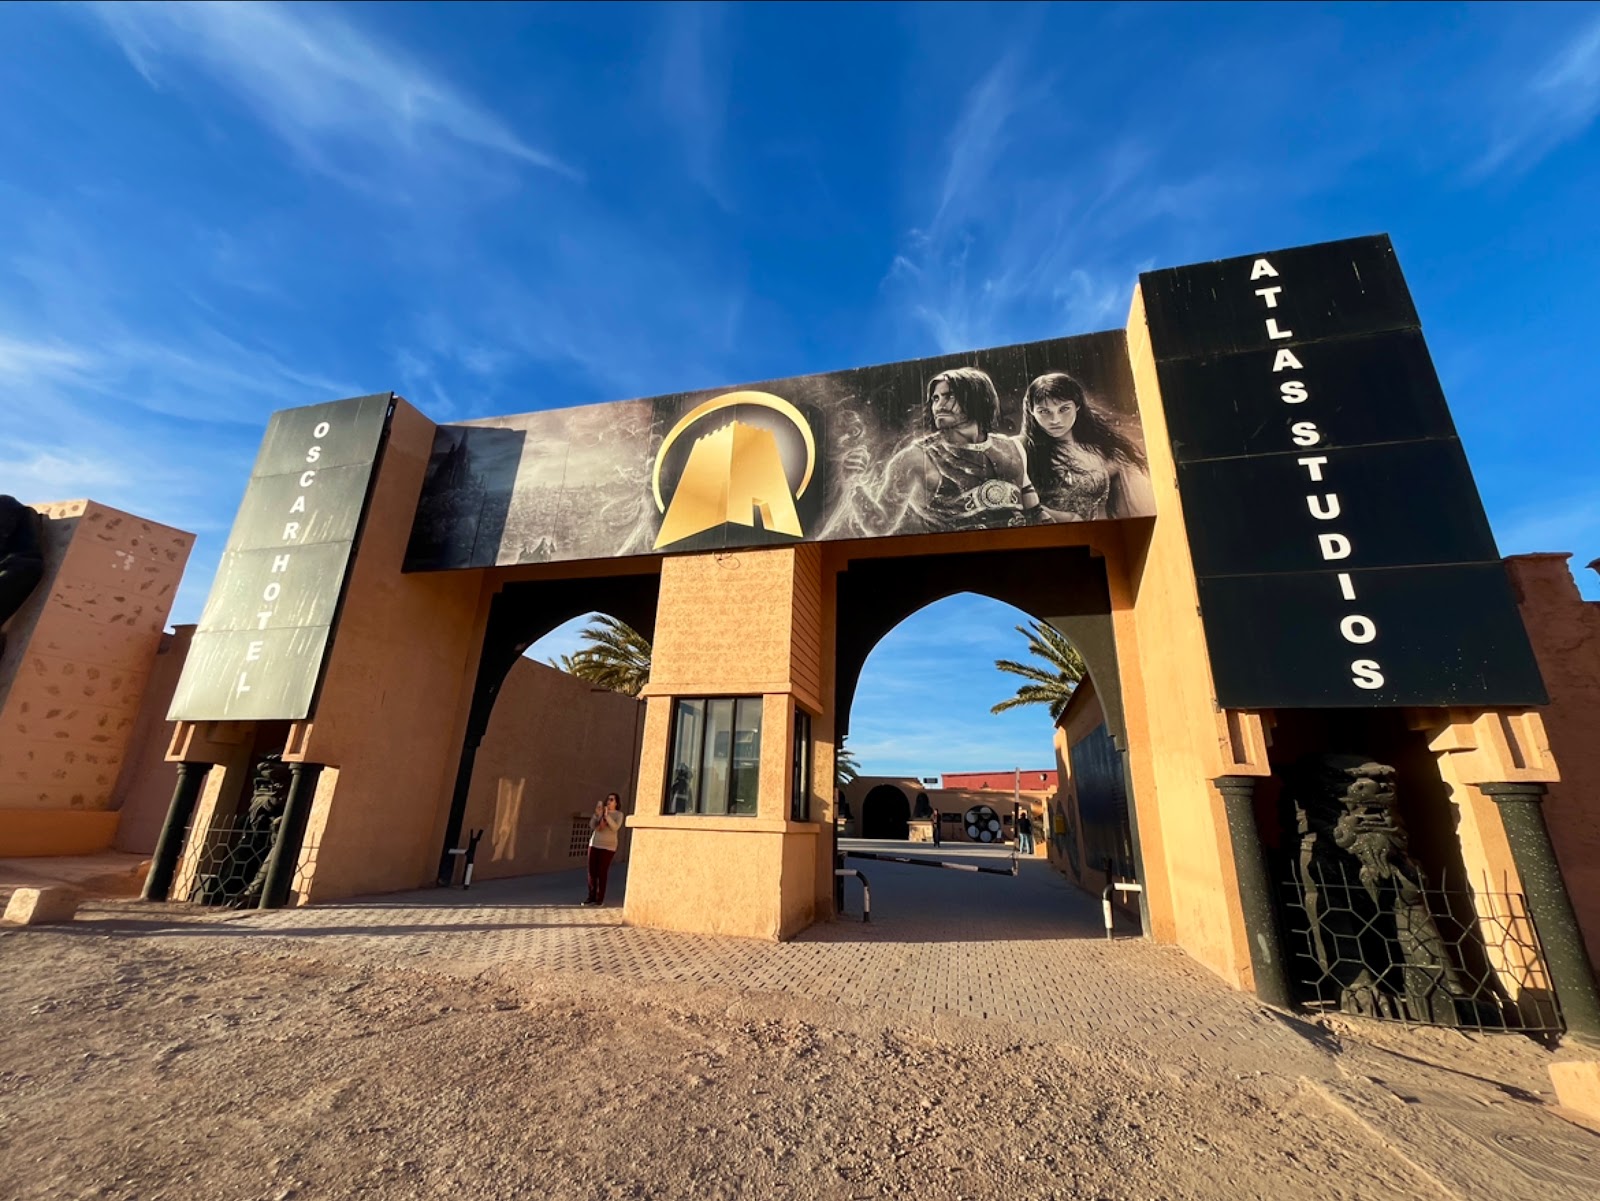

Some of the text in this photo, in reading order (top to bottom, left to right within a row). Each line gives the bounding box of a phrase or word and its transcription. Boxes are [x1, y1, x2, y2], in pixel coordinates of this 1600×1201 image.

[236, 422, 330, 692] OSCAR HOTEL
[1250, 258, 1385, 689] ATLAS STUDIOS
